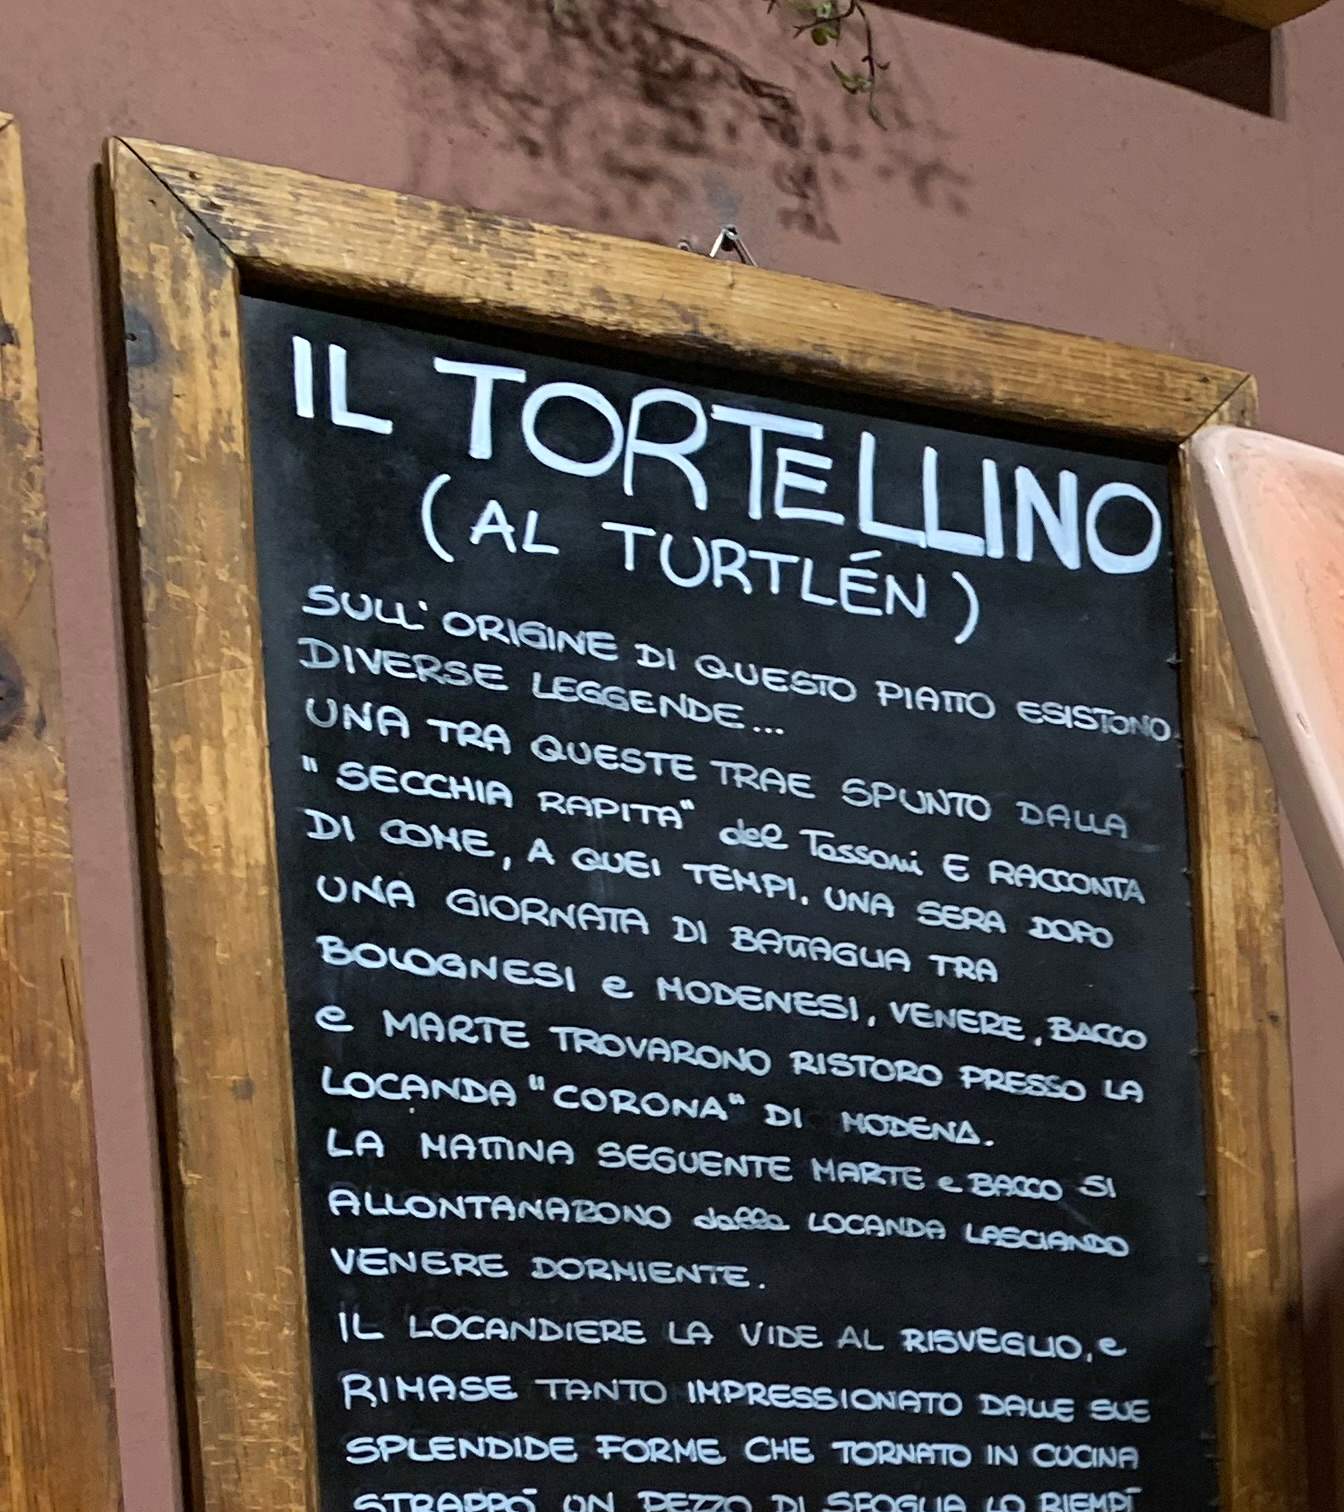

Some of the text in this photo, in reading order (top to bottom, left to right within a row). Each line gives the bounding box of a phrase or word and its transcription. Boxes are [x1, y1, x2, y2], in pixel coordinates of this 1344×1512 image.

[293, 336, 1163, 575] IL TORTELLINO
[298, 638, 789, 734] DIVERSE LEGGENDE...
[443, 612, 618, 661] ORIGINE
[635, 644, 675, 670] DI
[695, 655, 856, 702] QUESTO
[1017, 701, 1170, 741] ESISTONO
[306, 698, 1127, 838] UNA TRA QUESTE TRAE SPUNTO DALLA
[304, 809, 355, 841] DI
[528, 838, 555, 865] A
[571, 848, 661, 878] QUEI
[824, 887, 894, 917] UNA
[917, 901, 1006, 933] SERA
[1028, 917, 1113, 948] DOPO
[989, 860, 1145, 903] RACCONTA
[317, 876, 415, 908] UNA
[446, 889, 649, 935] GIORNATA
[672, 916, 707, 944] DI
[929, 955, 998, 982] TRA
[316, 936, 575, 992] BOLOGNESI
[1047, 1017, 1147, 1049] BACCO
[383, 1010, 530, 1048] MARTE
[549, 1027, 771, 1076] TROVARONO
[789, 1051, 942, 1086] RISTORO
[960, 1065, 1086, 1101] PRESSO
[1105, 1080, 1143, 1103] LA
[322, 1066, 994, 1146] LOCANDA "CORONA" DI MODENA.
[327, 1128, 384, 1157] LA
[421, 1133, 574, 1165] MATTINA
[597, 1142, 793, 1181] SEGUENTE
[811, 1158, 925, 1190] MARTE
[967, 1173, 1062, 1201] BACCO
[1078, 1175, 1116, 1198] SI
[331, 1248, 765, 1289] VENERE DORMIENTE.
[808, 1213, 945, 1239] LOCANDA
[965, 1223, 1129, 1256] LASCIANDO
[339, 1312, 384, 1342] IL
[410, 1314, 646, 1344] LOCANDIERE
[669, 1321, 713, 1344] LA
[740, 1322, 823, 1348] VIDE
[838, 1326, 884, 1350] AL
[342, 1374, 1150, 1422] RIMASE TANTO IMPRESSIONATO DALLE SUE
[346, 1435, 1138, 1468] SPLENDIDE FORME CHE TORNATO IN CUCINA
